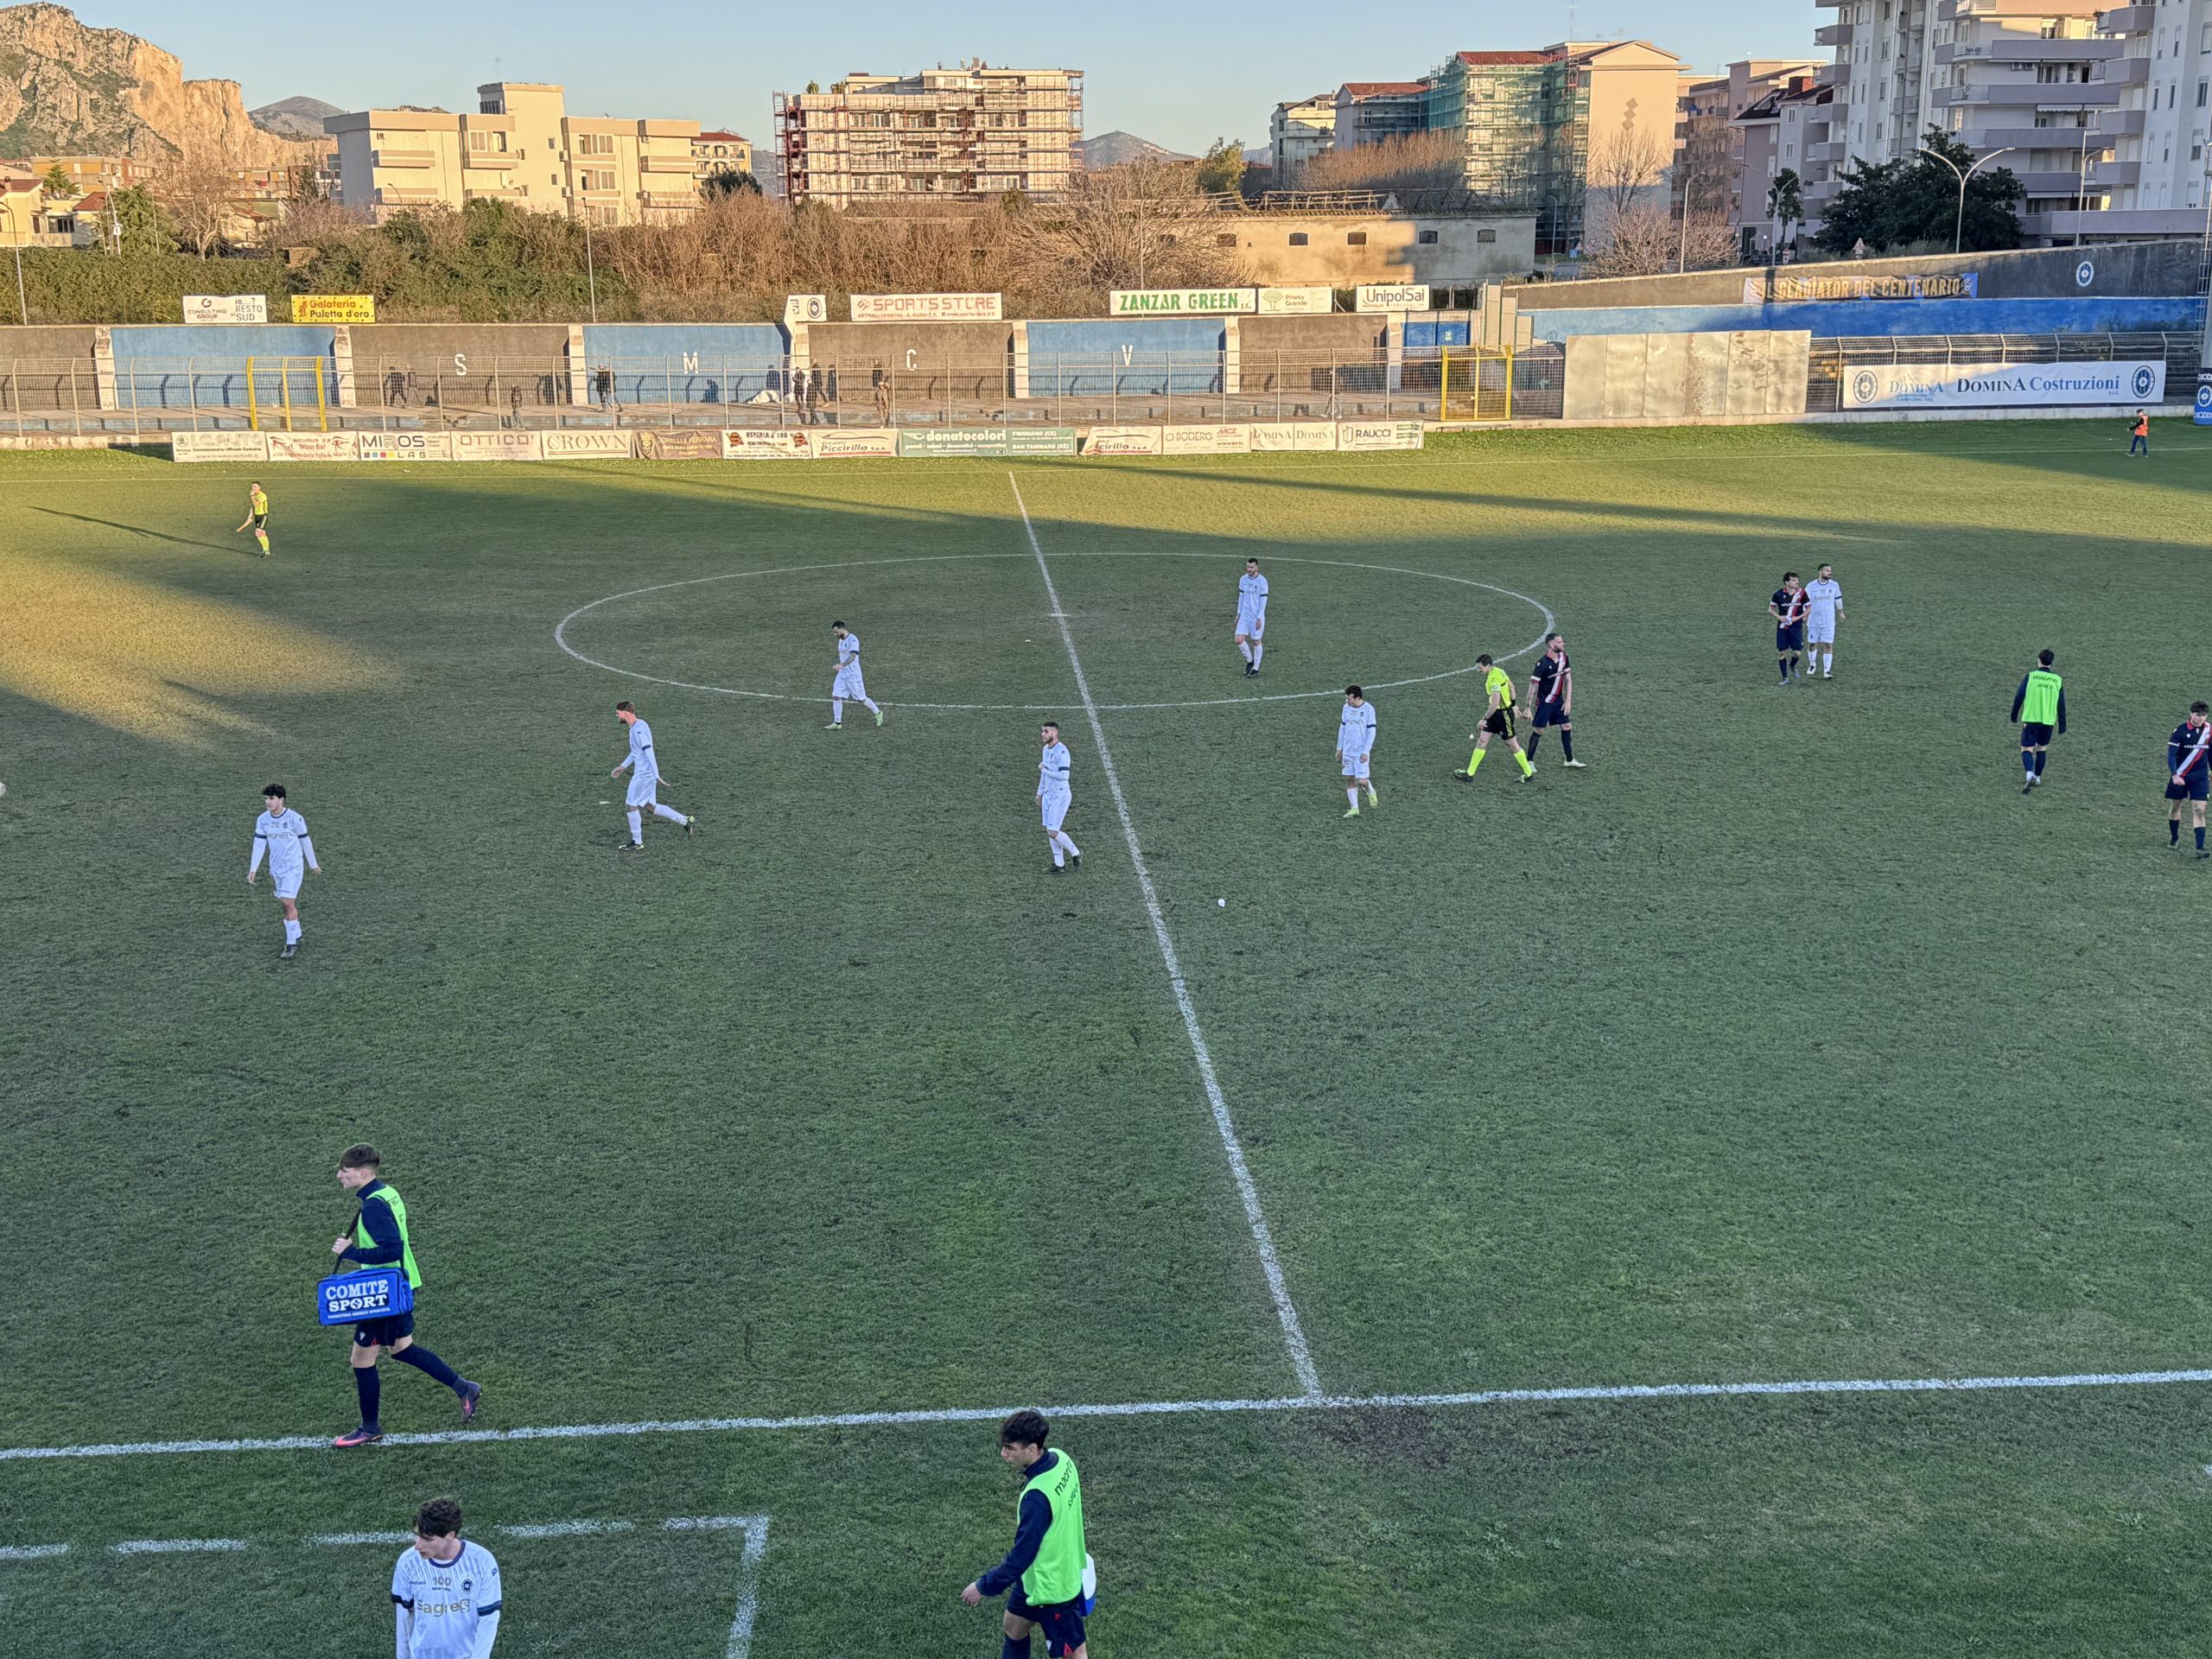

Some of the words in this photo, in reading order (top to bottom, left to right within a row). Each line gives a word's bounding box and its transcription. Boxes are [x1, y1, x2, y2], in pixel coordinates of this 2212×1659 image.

[1366, 288, 1425, 307] UnipolSai
[1778, 279, 1849, 299] GLADIATOR
[1853, 279, 1877, 298] DEL
[1881, 277, 1960, 297] CENTENARIO
[874, 297, 938, 311] SPORTS
[1120, 293, 1180, 311] ZANZAR
[1188, 292, 1238, 309] GREEN
[454, 353, 467, 376] S
[683, 352, 698, 374] M
[1122, 345, 1133, 366] V
[2030, 375, 2120, 391] Costruzioni
[361, 435, 425, 448] MIROS
[548, 435, 626, 449] CROWN
[926, 429, 1007, 442] donatocolori
[1355, 429, 1391, 438] RAUCCI
[326, 1279, 389, 1300] COMITE
[328, 1294, 388, 1313] SPORT
[432, 1576, 451, 1586] 100
